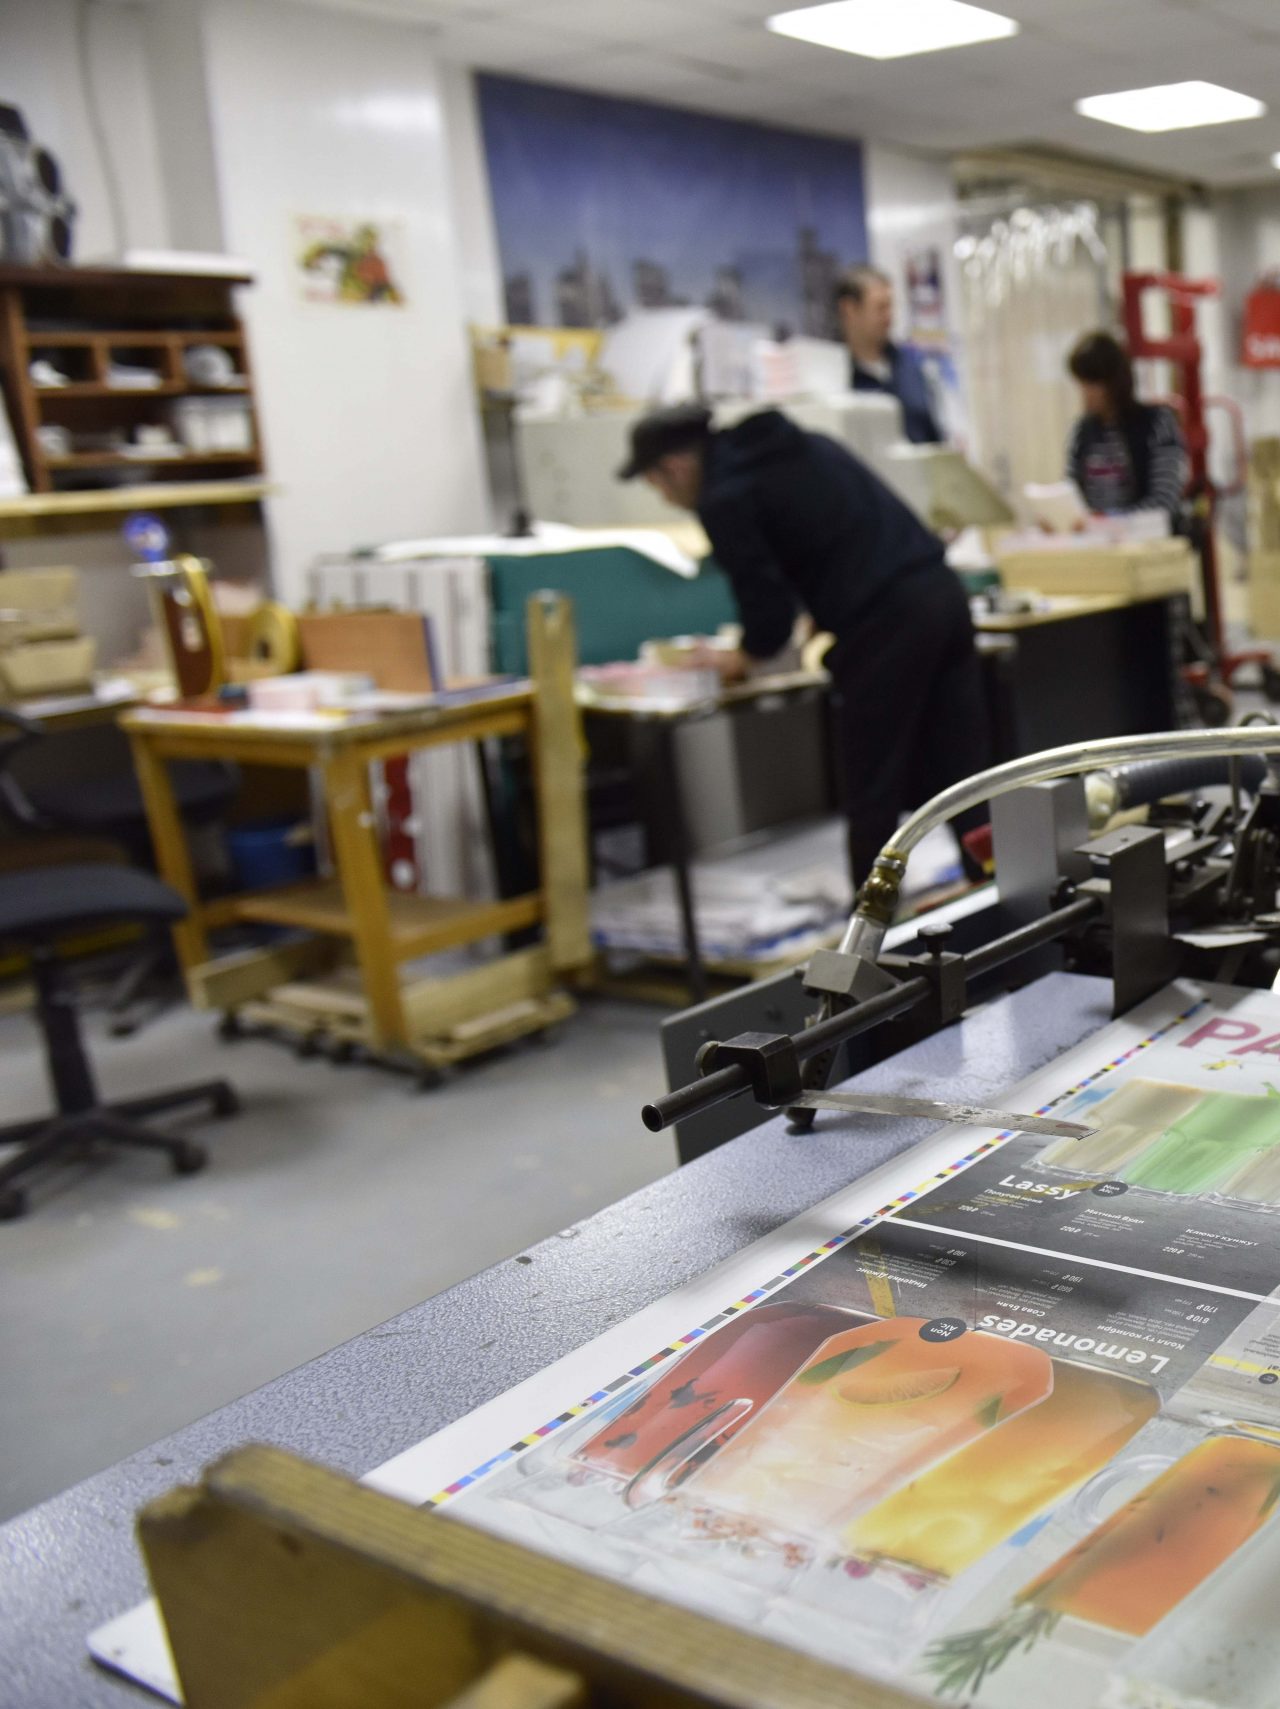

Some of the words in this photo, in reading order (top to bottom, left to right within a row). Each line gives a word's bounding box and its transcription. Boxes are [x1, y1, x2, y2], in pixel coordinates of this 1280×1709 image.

[998, 1174, 1081, 1200] Lassy
[856, 1267, 889, 1279] Джонс
[888, 1274, 928, 1289] Индейка
[996, 1301, 1020, 1311] Бьян
[1021, 1307, 1046, 1317] Сова
[930, 1327, 952, 1337] Non
[939, 1322, 958, 1332] Alc.
[1096, 1325, 1142, 1339] колибри
[977, 1315, 1170, 1374] Lemonades
[1142, 1335, 1156, 1344] ту
[1156, 1338, 1185, 1351] Колл
